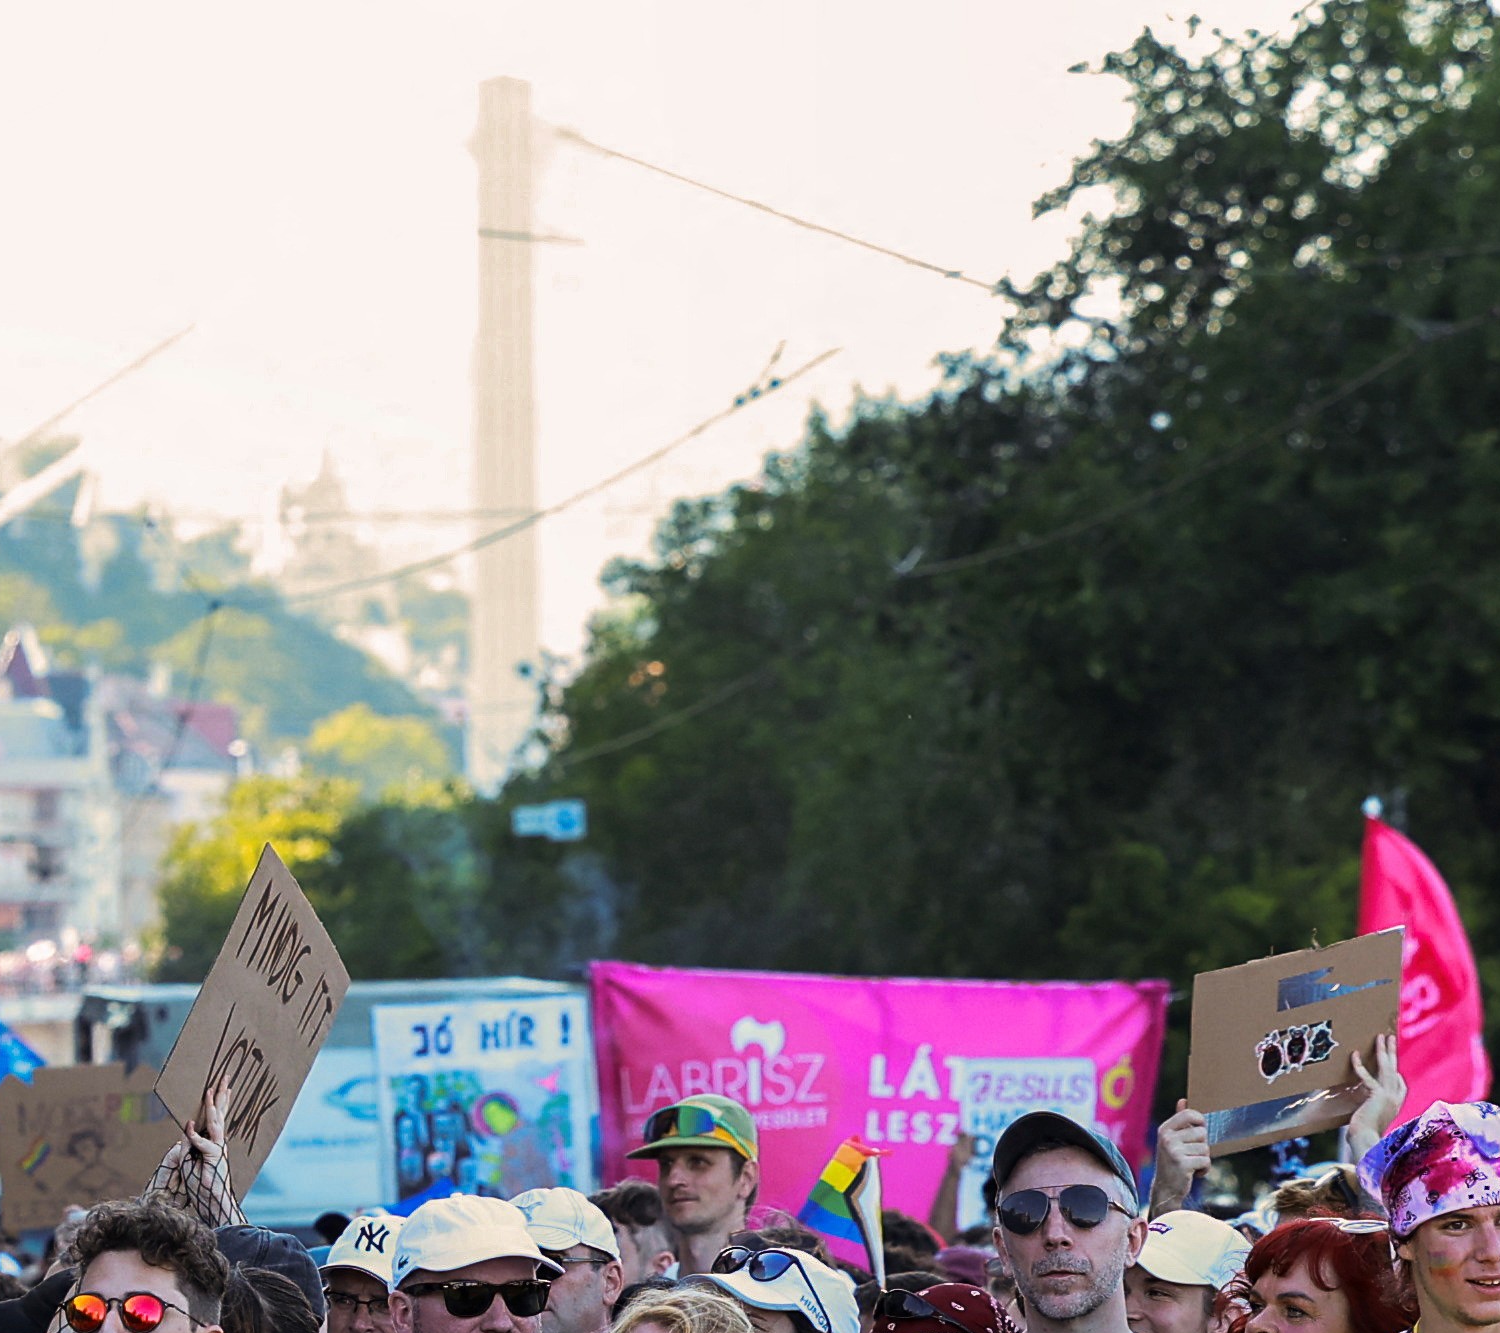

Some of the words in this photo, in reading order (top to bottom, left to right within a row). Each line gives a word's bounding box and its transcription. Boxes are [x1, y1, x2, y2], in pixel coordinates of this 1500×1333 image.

[236, 878, 312, 1005] MINDIG
[297, 972, 333, 1048] ITT
[480, 1007, 536, 1051] HÍR
[620, 1053, 828, 1114] LABRISZ
[968, 1071, 1091, 1105] JESUS
[354, 1221, 391, 1254] NY
